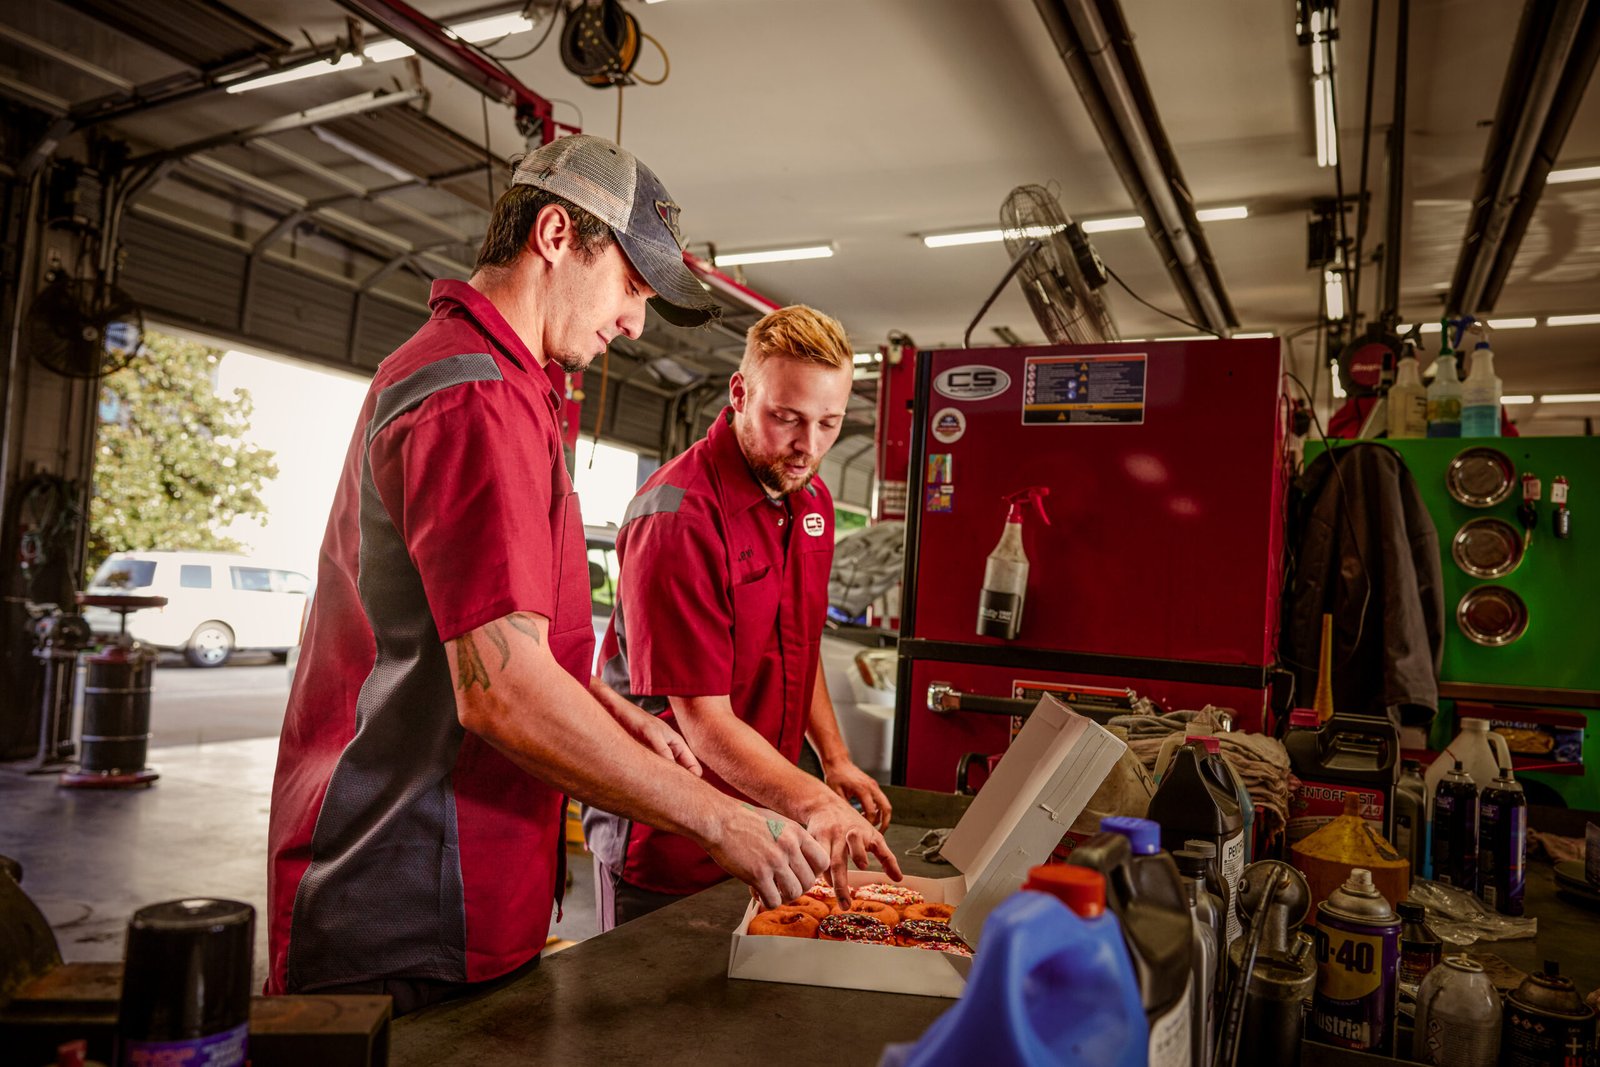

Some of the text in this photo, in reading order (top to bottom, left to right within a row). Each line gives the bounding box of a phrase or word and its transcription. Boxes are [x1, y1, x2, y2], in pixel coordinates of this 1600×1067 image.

[948, 372, 996, 387] CS
[805, 517, 822, 529] CS
[1315, 928, 1374, 974] D-40
[1315, 1010, 1370, 1044] ustrial
